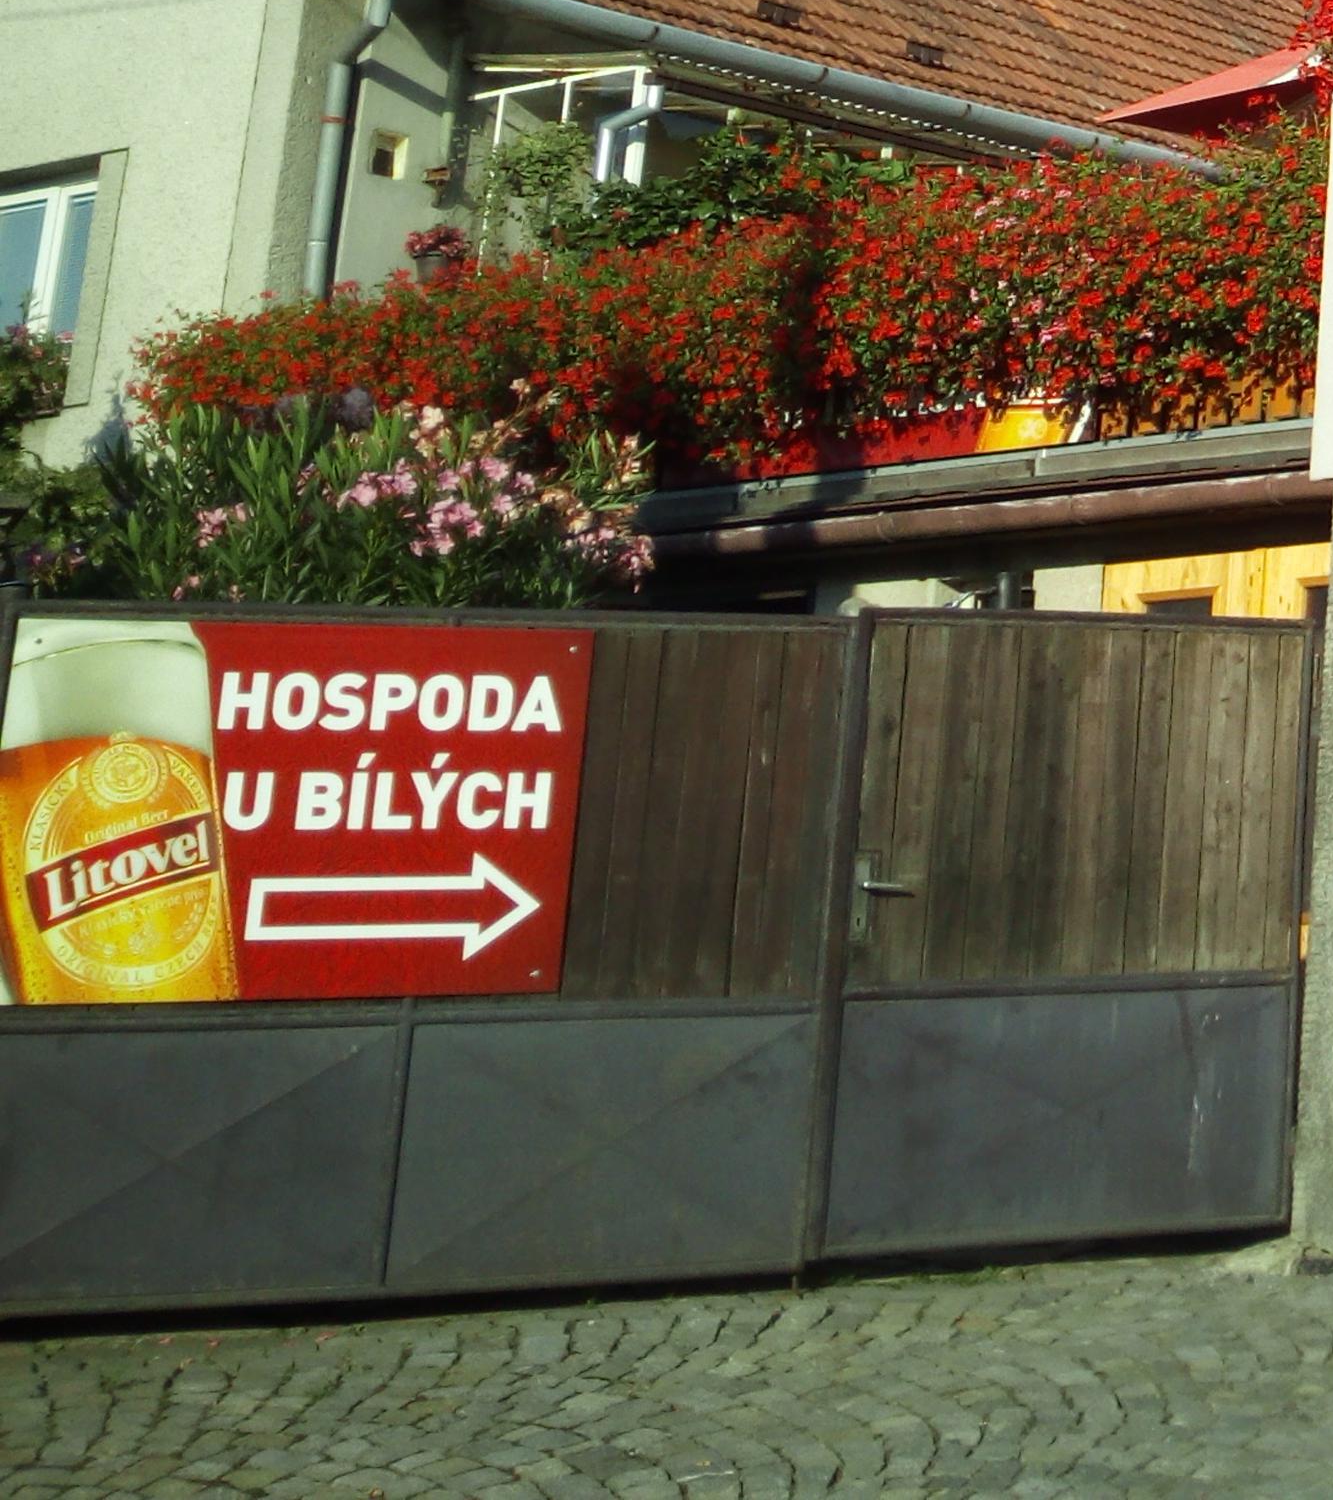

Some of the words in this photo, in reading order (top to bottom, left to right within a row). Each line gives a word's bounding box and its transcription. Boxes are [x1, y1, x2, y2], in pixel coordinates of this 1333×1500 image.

[216, 671, 562, 733] HOSPODA
[30, 777, 73, 852] KLASICKY
[222, 771, 274, 832] U
[293, 752, 553, 832] BÍLÝCH
[84, 818, 138, 845] Original
[141, 808, 169, 826] Beer
[44, 820, 210, 921] Litovel
[57, 945, 145, 983] ORIGINAL
[156, 941, 204, 979] CZECH
